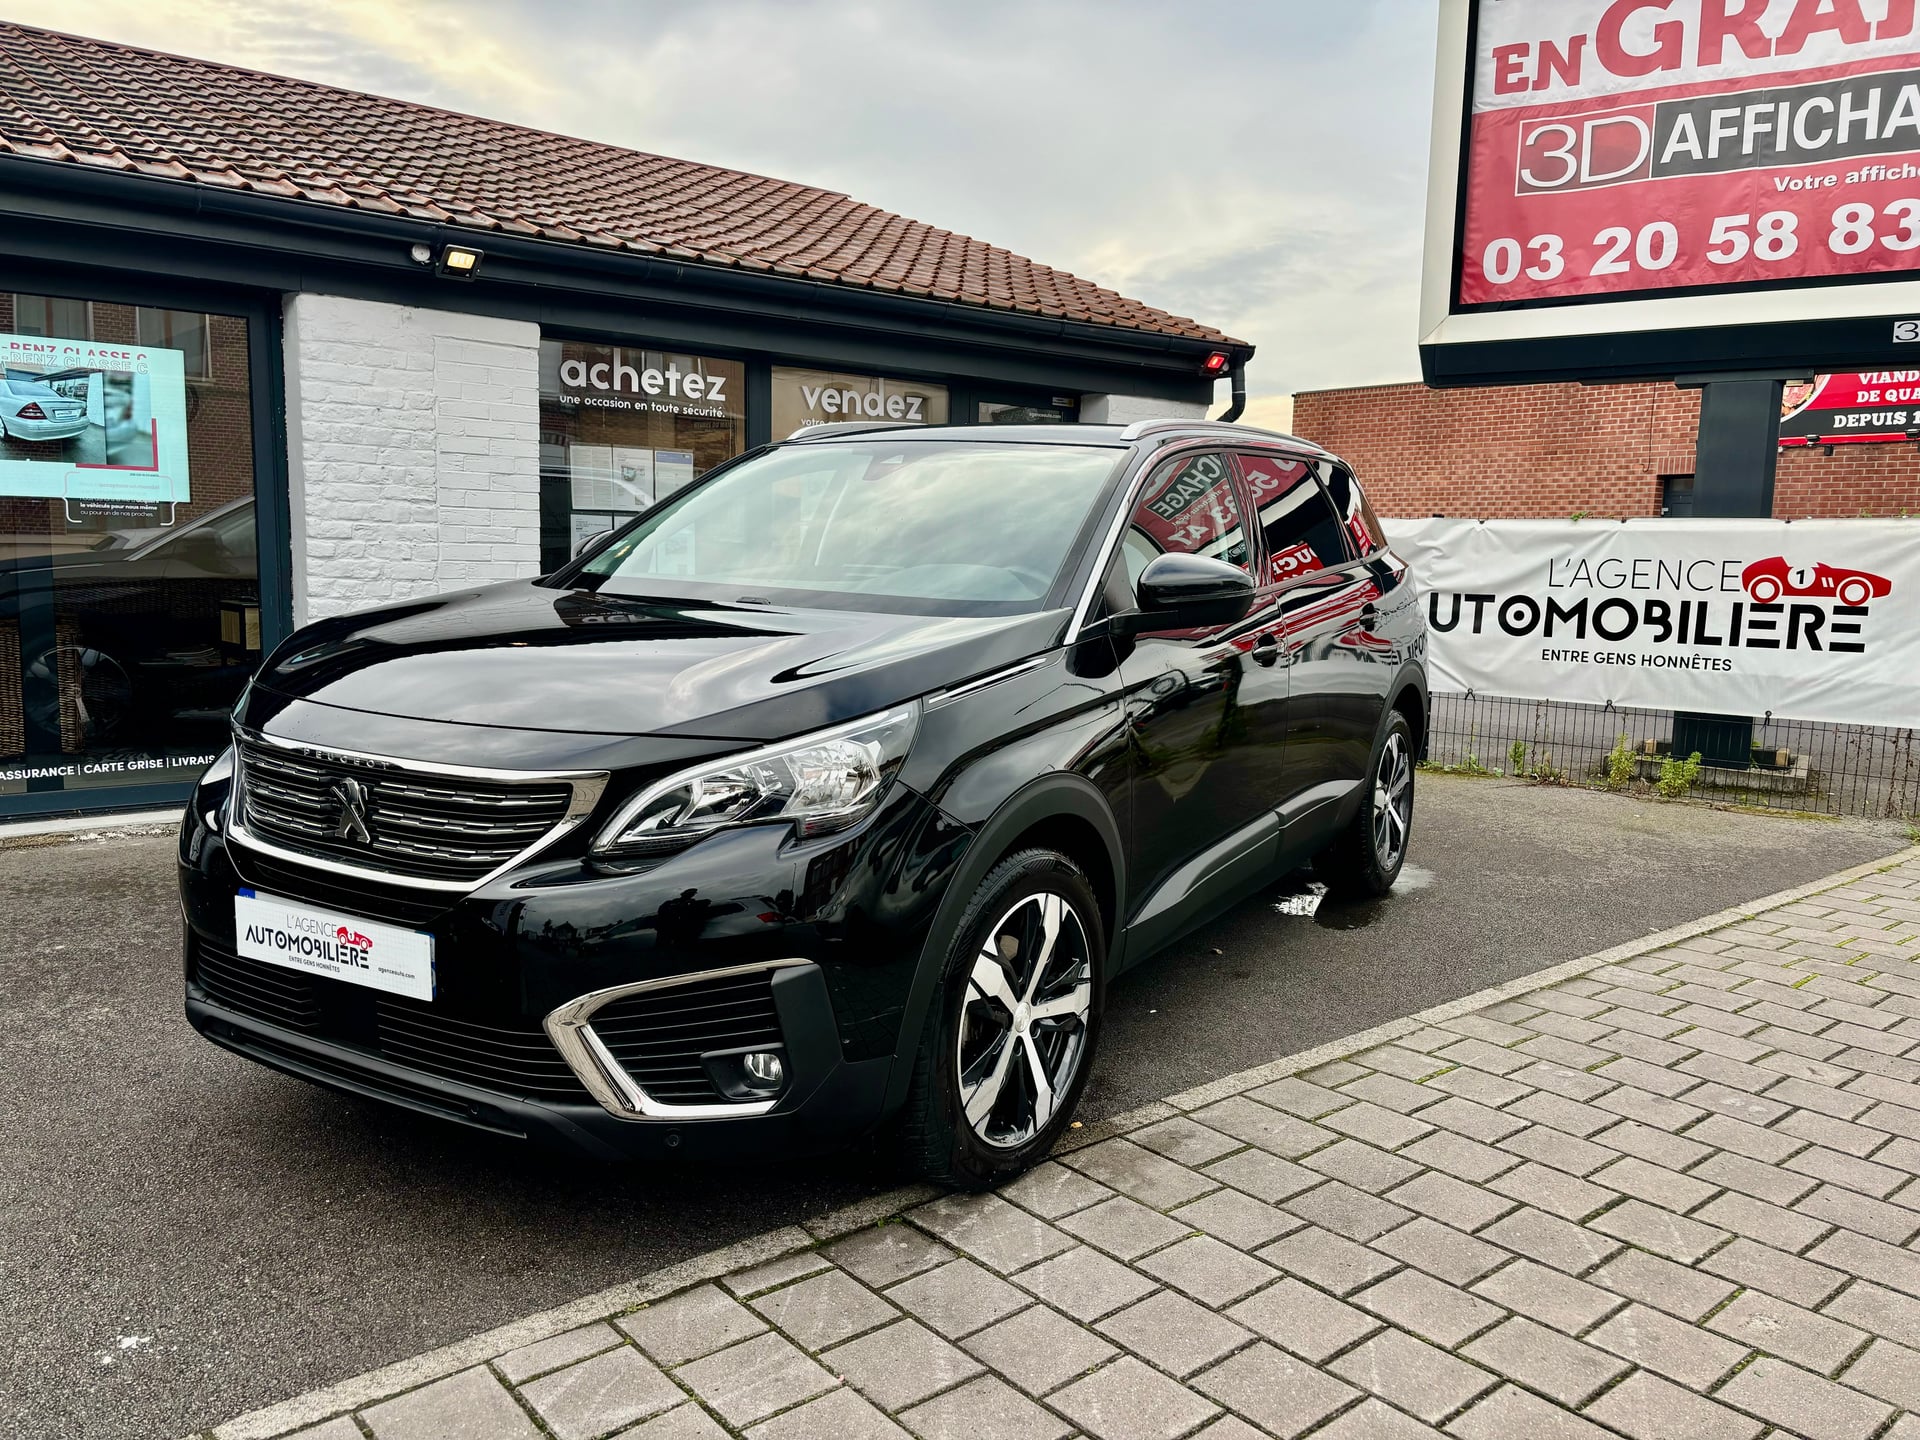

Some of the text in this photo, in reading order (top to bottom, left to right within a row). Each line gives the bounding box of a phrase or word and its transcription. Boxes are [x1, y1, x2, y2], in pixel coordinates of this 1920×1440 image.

[1492, 34, 1587, 95] EN
[1521, 83, 1920, 188] 3D AFFICHA
[1773, 162, 1920, 193] Votre affich
[1483, 197, 1920, 284] 03 20 58 83
[560, 347, 727, 402] achetez
[1858, 370, 1920, 385] VIAND
[559, 395, 726, 418] une occasion en toute sécurité.
[801, 377, 924, 421] vendez
[1856, 390, 1881, 403] DE
[1833, 412, 1908, 428] DEPUIS
[1548, 558, 1743, 593] L'AGENCE
[1796, 569, 1805, 585] 1
[1541, 648, 1732, 672] ENTRE GENS HONNÊTES
[0, 765, 75, 781] ASSURANCE
[83, 761, 125, 774] CARTE
[127, 758, 164, 770] GRISE
[303, 748, 390, 770] PEUGEOT
[286, 913, 338, 939] L'AGENCE
[288, 955, 303, 965] ENTRE
[303, 959, 316, 967] GENS
